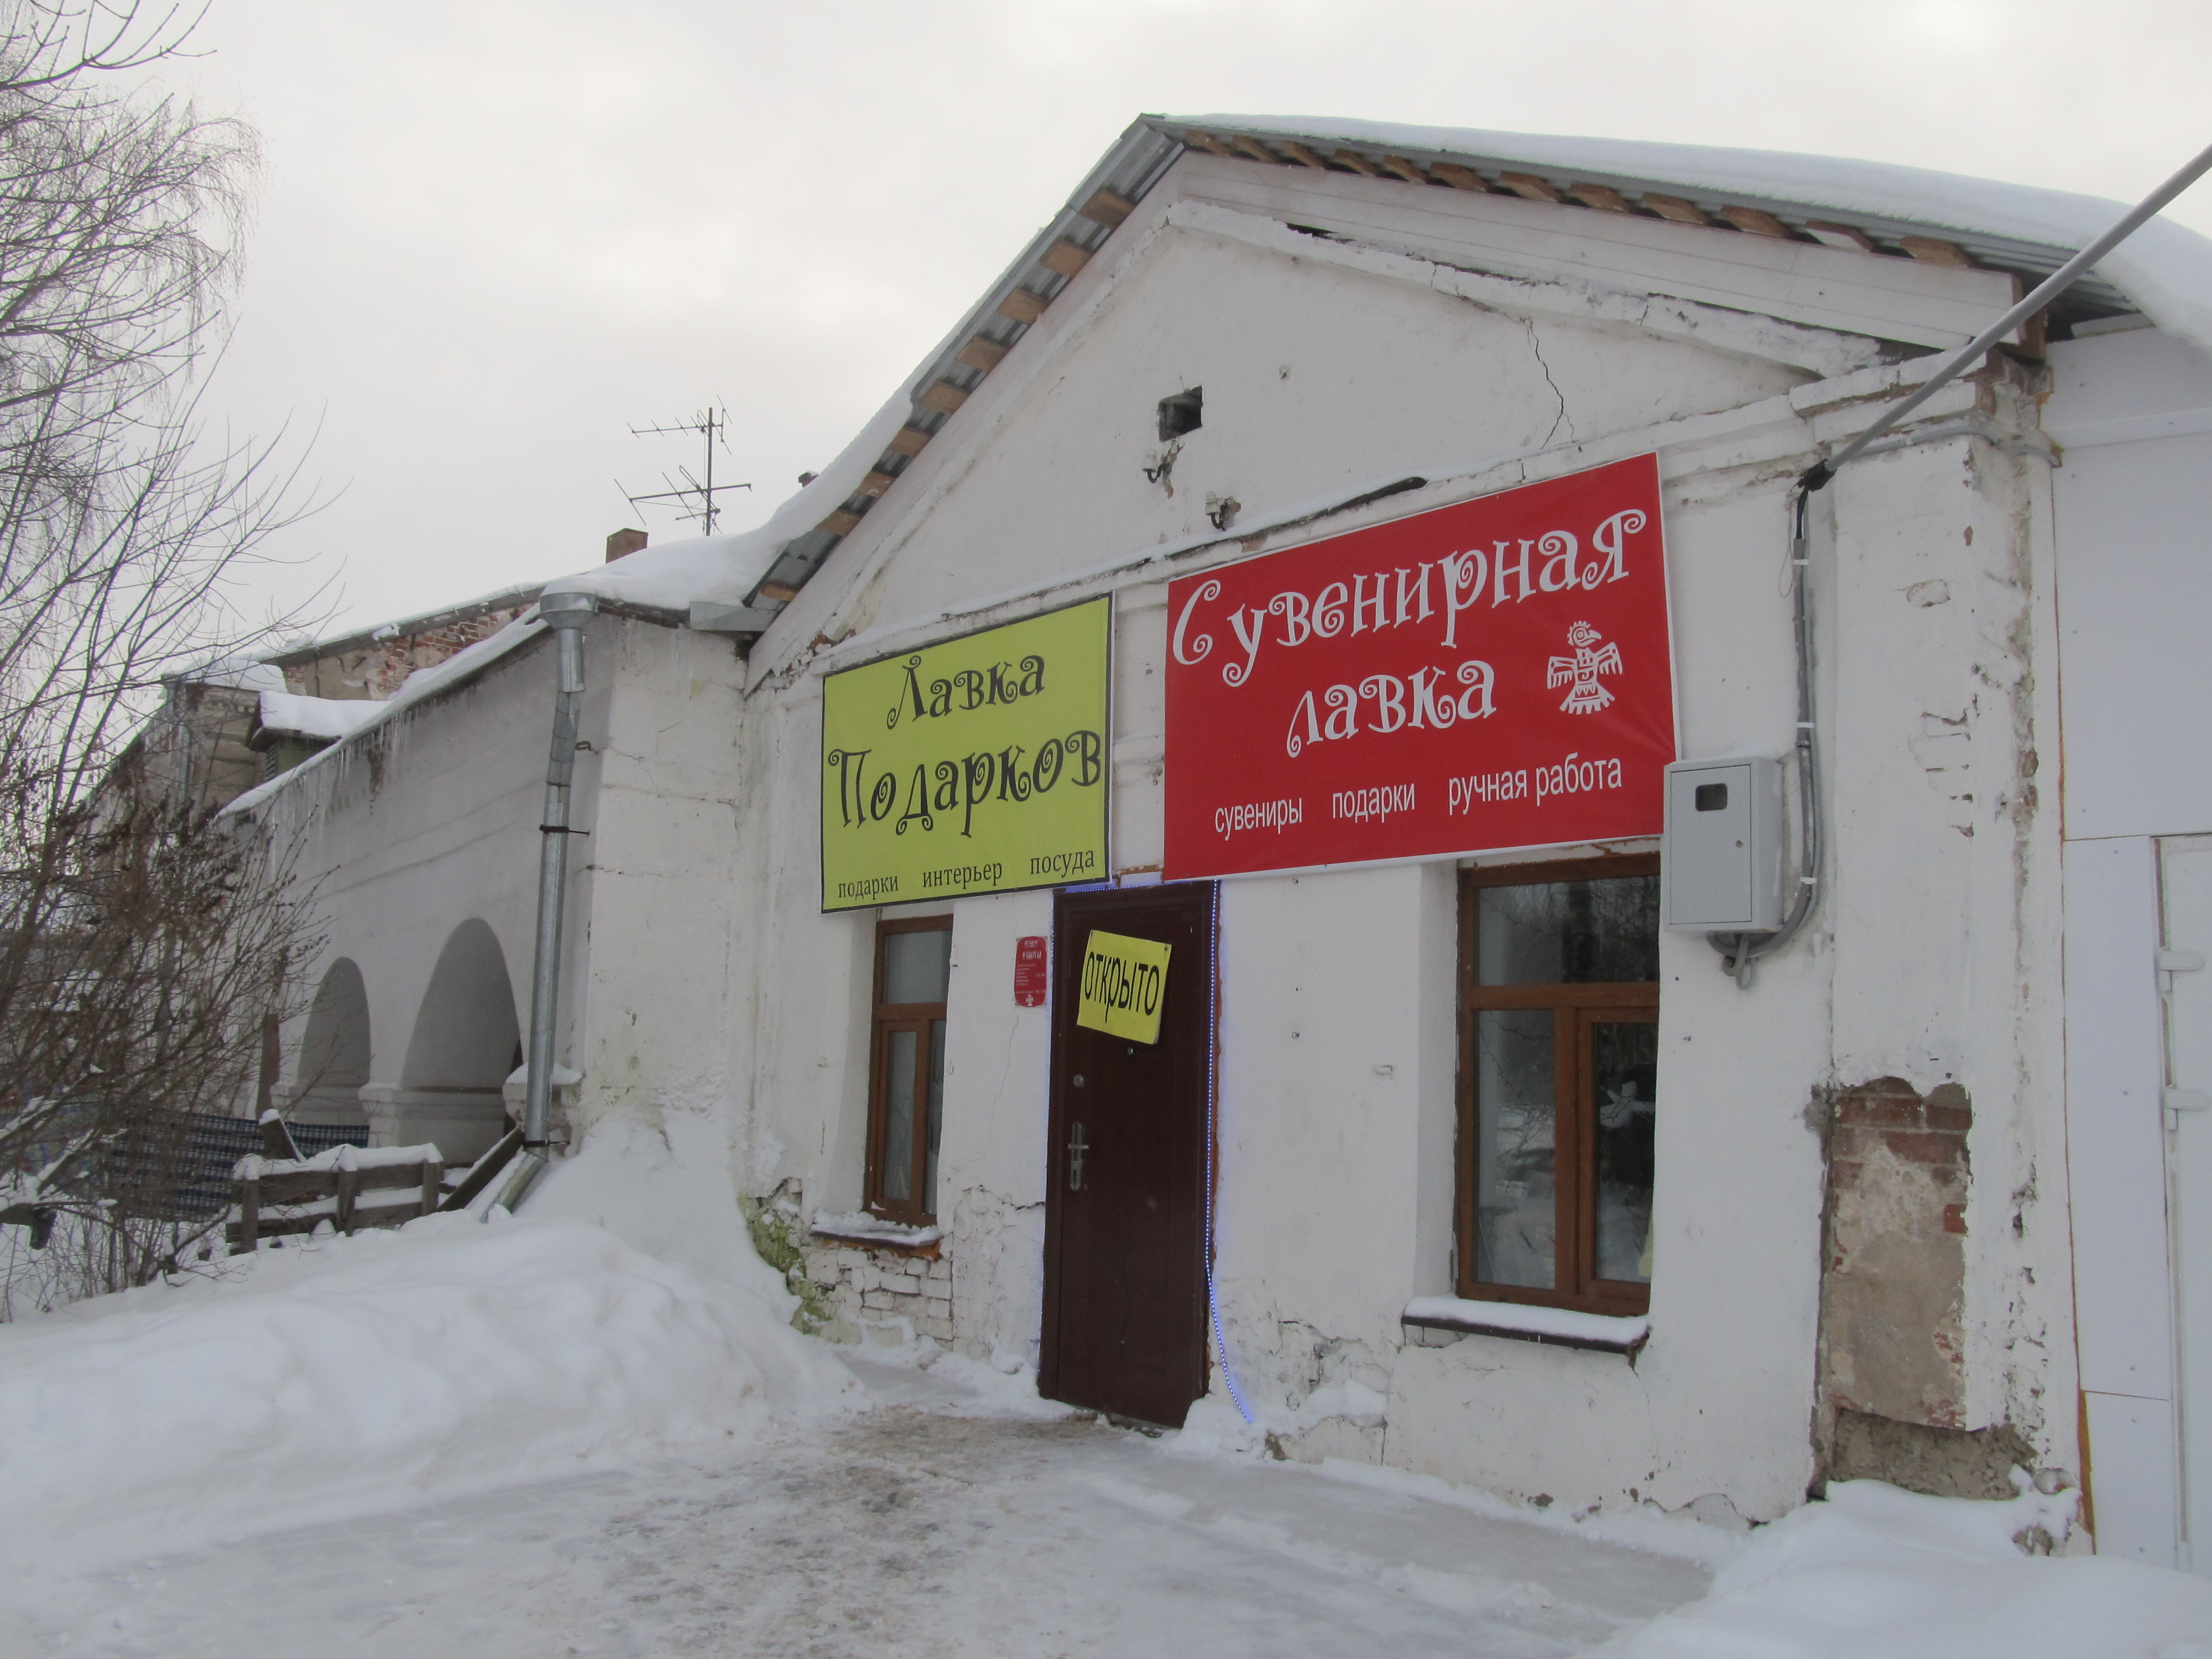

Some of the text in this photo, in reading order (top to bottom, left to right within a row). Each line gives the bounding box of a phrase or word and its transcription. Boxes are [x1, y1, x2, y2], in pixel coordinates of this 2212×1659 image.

[1172, 508, 1647, 687] Сувенирная
[886, 655, 1045, 730] Лавка
[828, 730, 1102, 838] Подарков
[1215, 752, 1622, 841] сувениры подарки ручная работа
[838, 850, 1094, 900] подарки интерьер посуда
